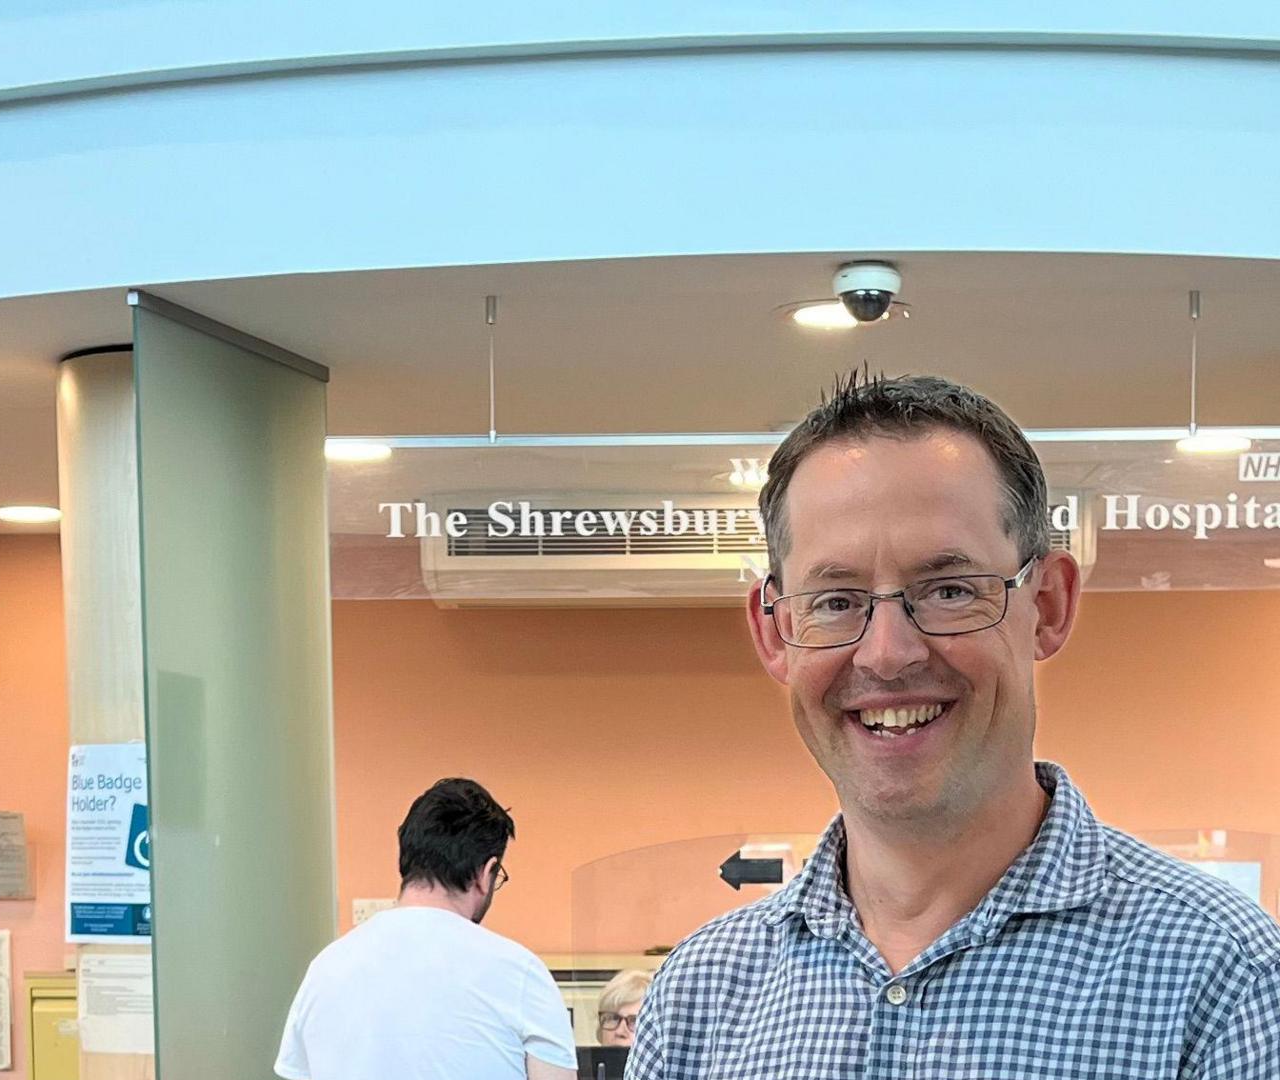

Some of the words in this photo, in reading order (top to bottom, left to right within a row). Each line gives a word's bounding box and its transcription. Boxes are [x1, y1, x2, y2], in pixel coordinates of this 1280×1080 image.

[378, 502, 468, 537] The
[72, 774, 94, 790] Blue
[98, 774, 142, 793] Badge
[72, 796, 117, 812] Holder?
